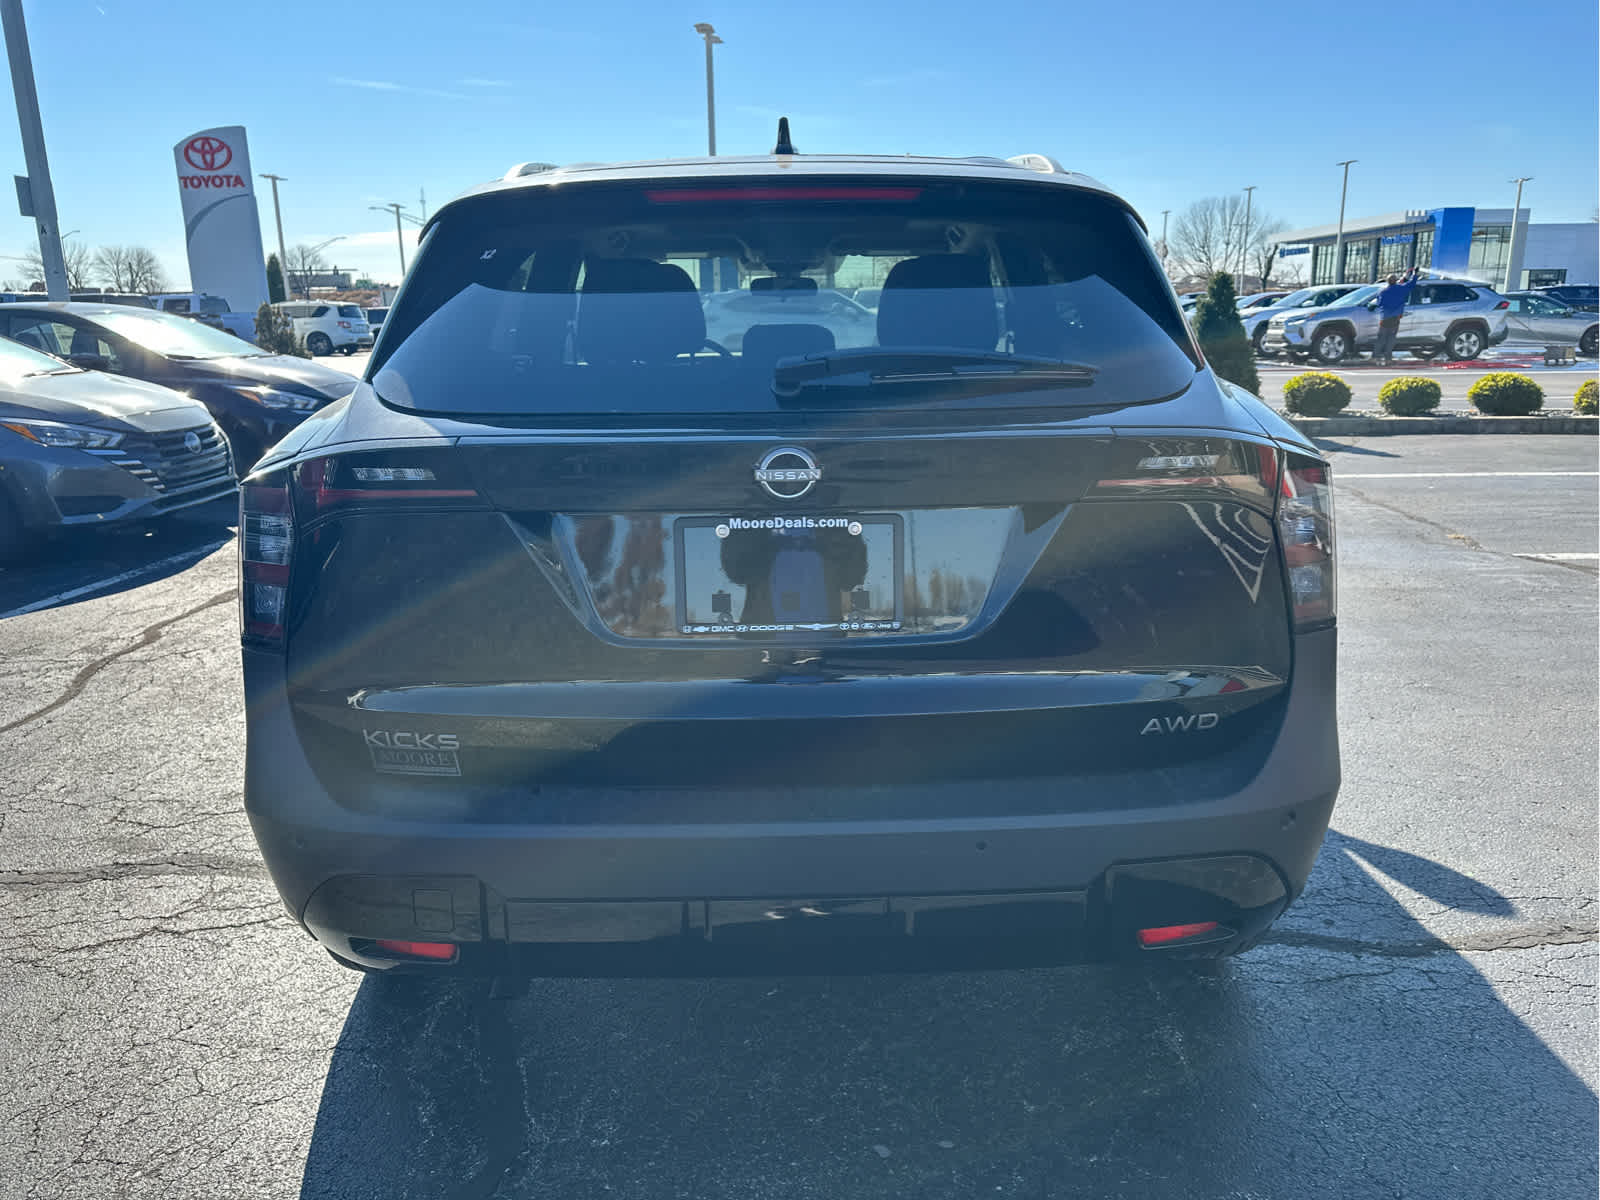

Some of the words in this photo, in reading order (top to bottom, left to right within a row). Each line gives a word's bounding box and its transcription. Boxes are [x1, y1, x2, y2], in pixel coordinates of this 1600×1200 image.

[180, 174, 245, 190] TOYOTA
[755, 470, 821, 480] NISSAN
[728, 516, 849, 529] MooreDeals.com
[711, 625, 735, 633] GMC
[1140, 712, 1219, 735] AWD
[362, 729, 460, 750] KICKS
